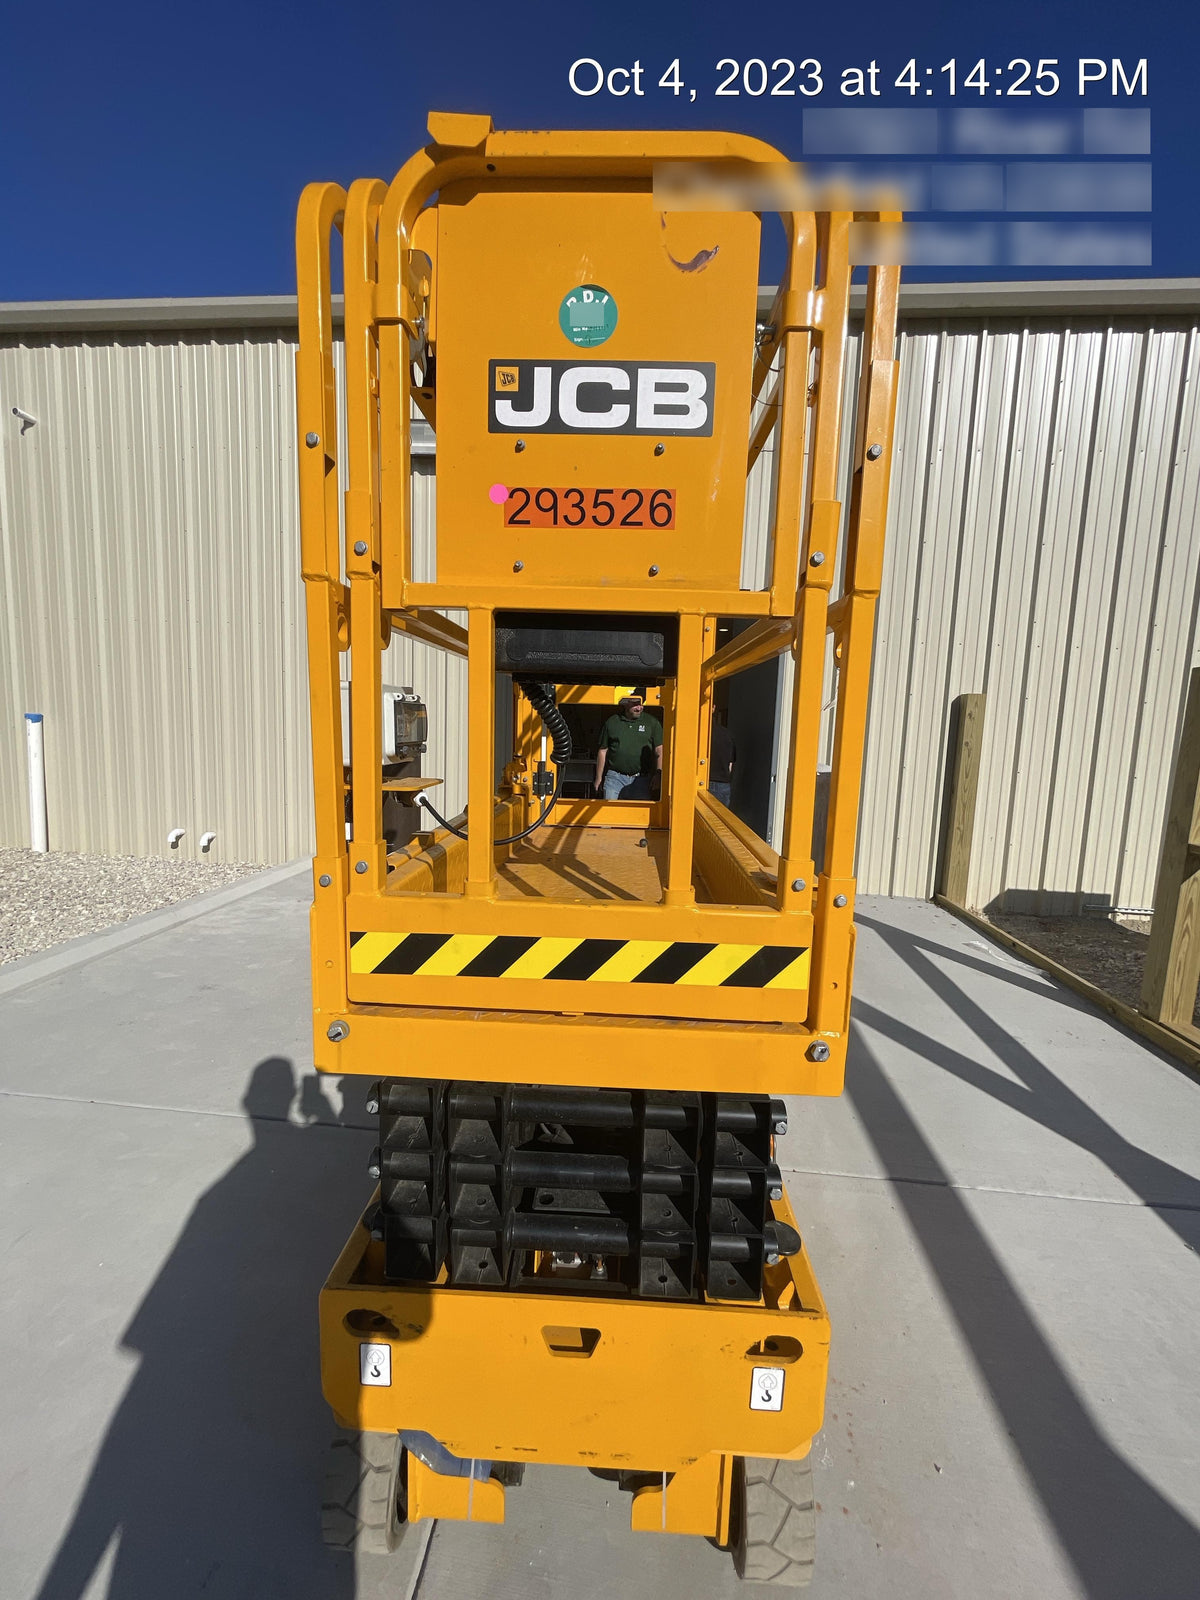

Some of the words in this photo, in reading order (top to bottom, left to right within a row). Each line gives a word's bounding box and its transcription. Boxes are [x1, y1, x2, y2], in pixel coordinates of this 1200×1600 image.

[495, 366, 708, 430] JCB
[501, 372, 516, 385] JCB
[507, 487, 673, 527] 293526
